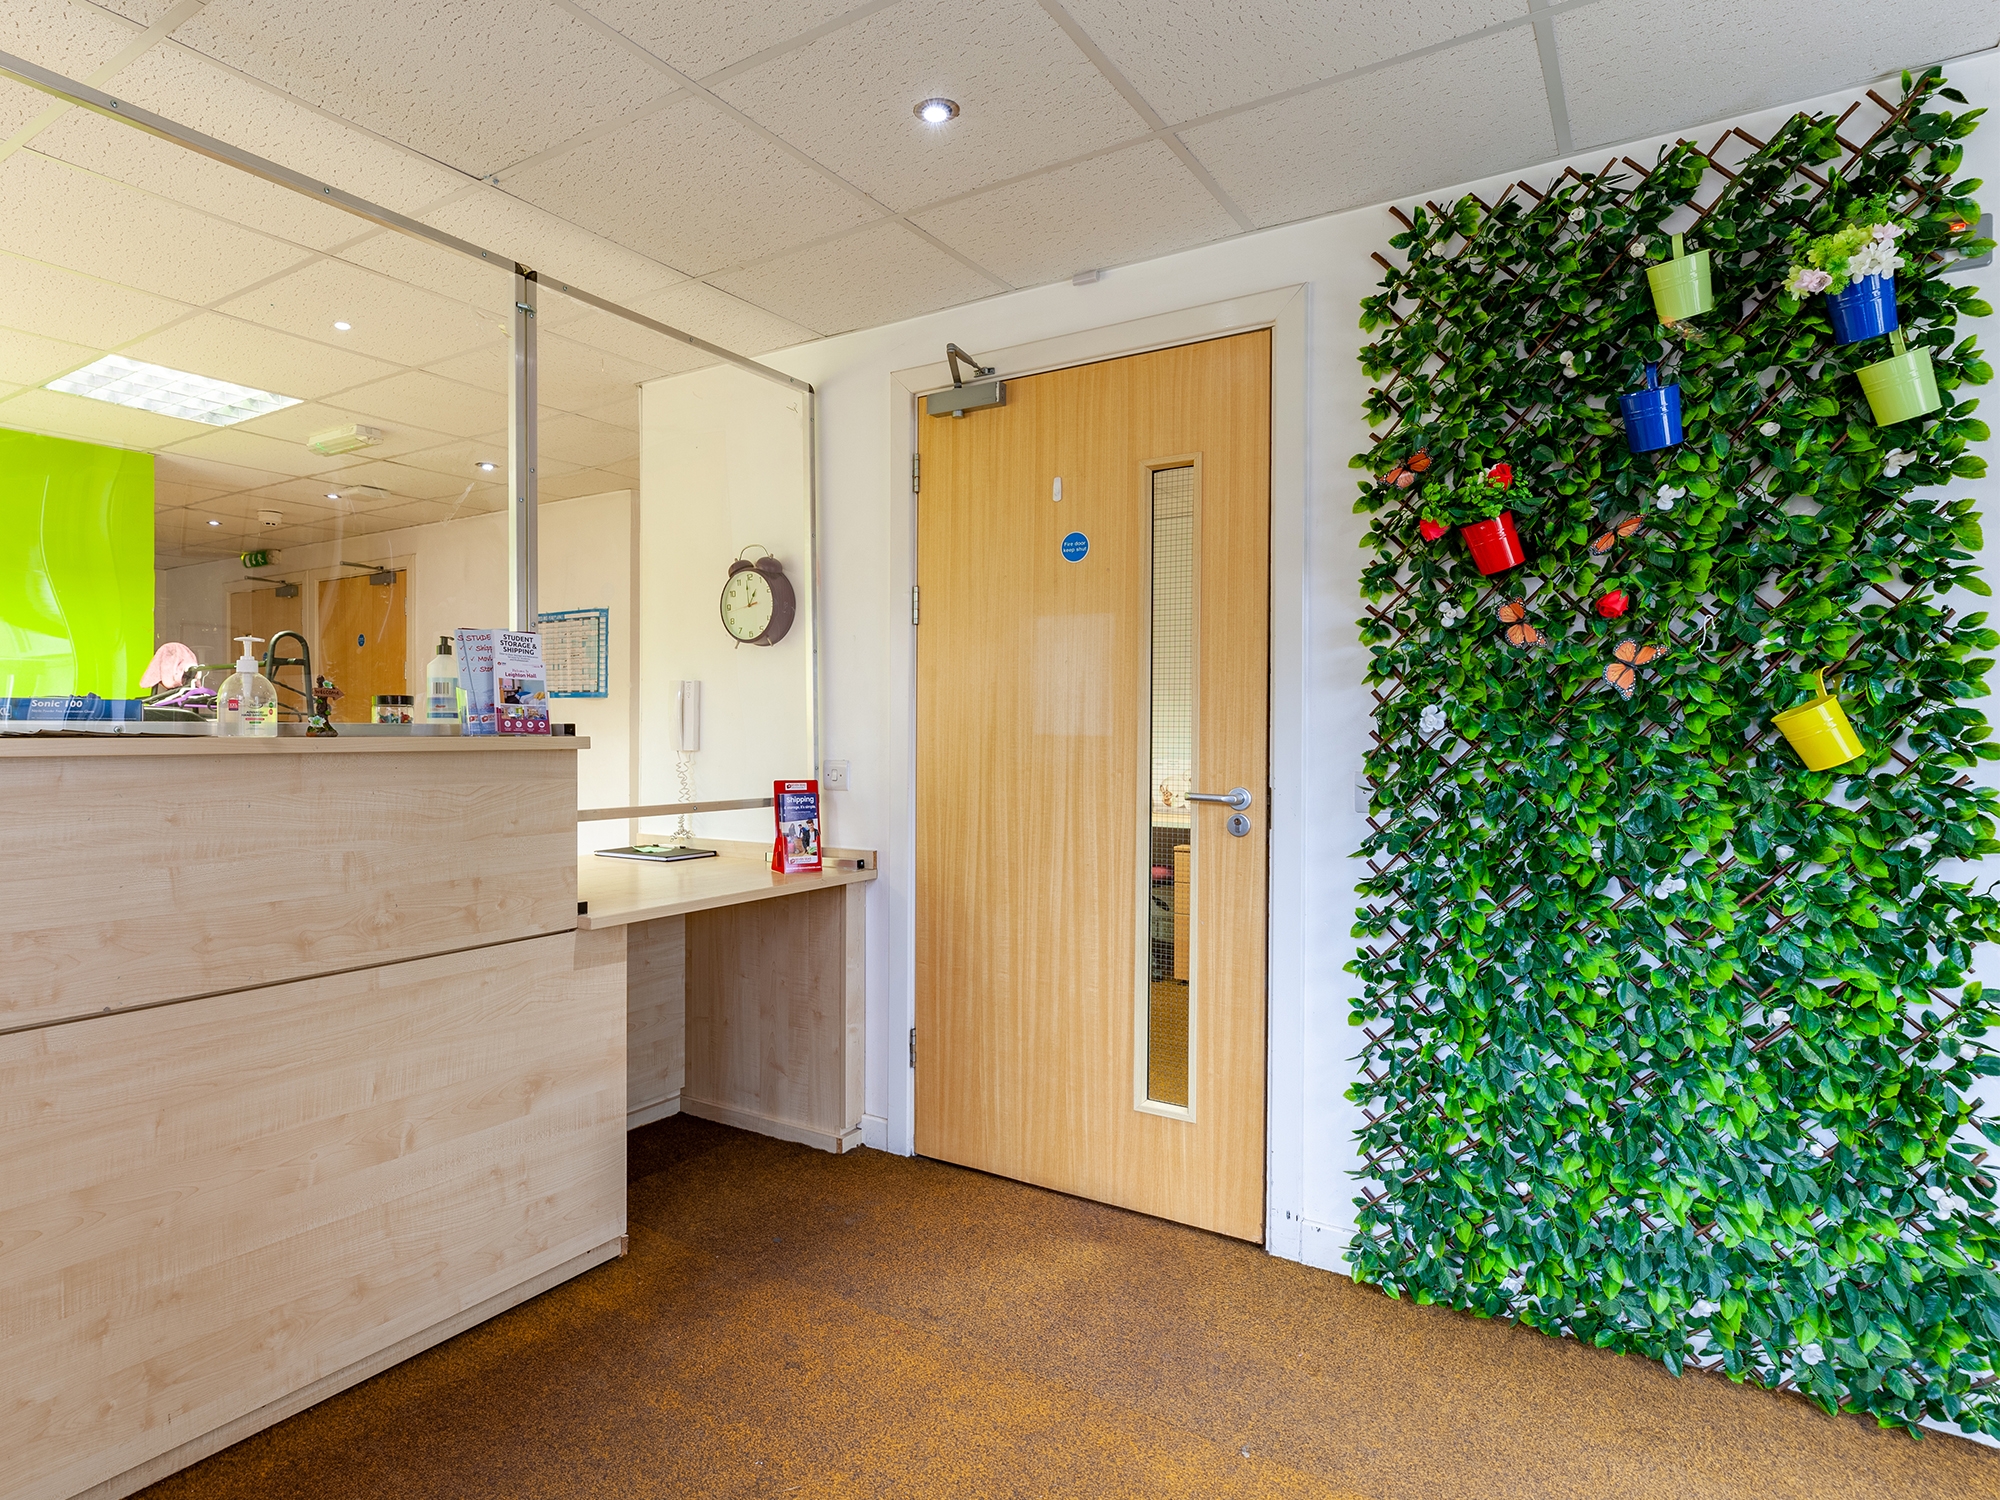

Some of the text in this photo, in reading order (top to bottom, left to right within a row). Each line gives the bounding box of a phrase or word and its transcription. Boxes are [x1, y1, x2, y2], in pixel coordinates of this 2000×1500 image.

[730, 590, 736, 598] 10
[730, 617, 735, 625] 8
[503, 634, 533, 643] STUDENT
[500, 640, 531, 649] STORAGE
[503, 647, 534, 655] SHIPPING
[65, 700, 83, 708] 100
[786, 796, 815, 805] Shipping
